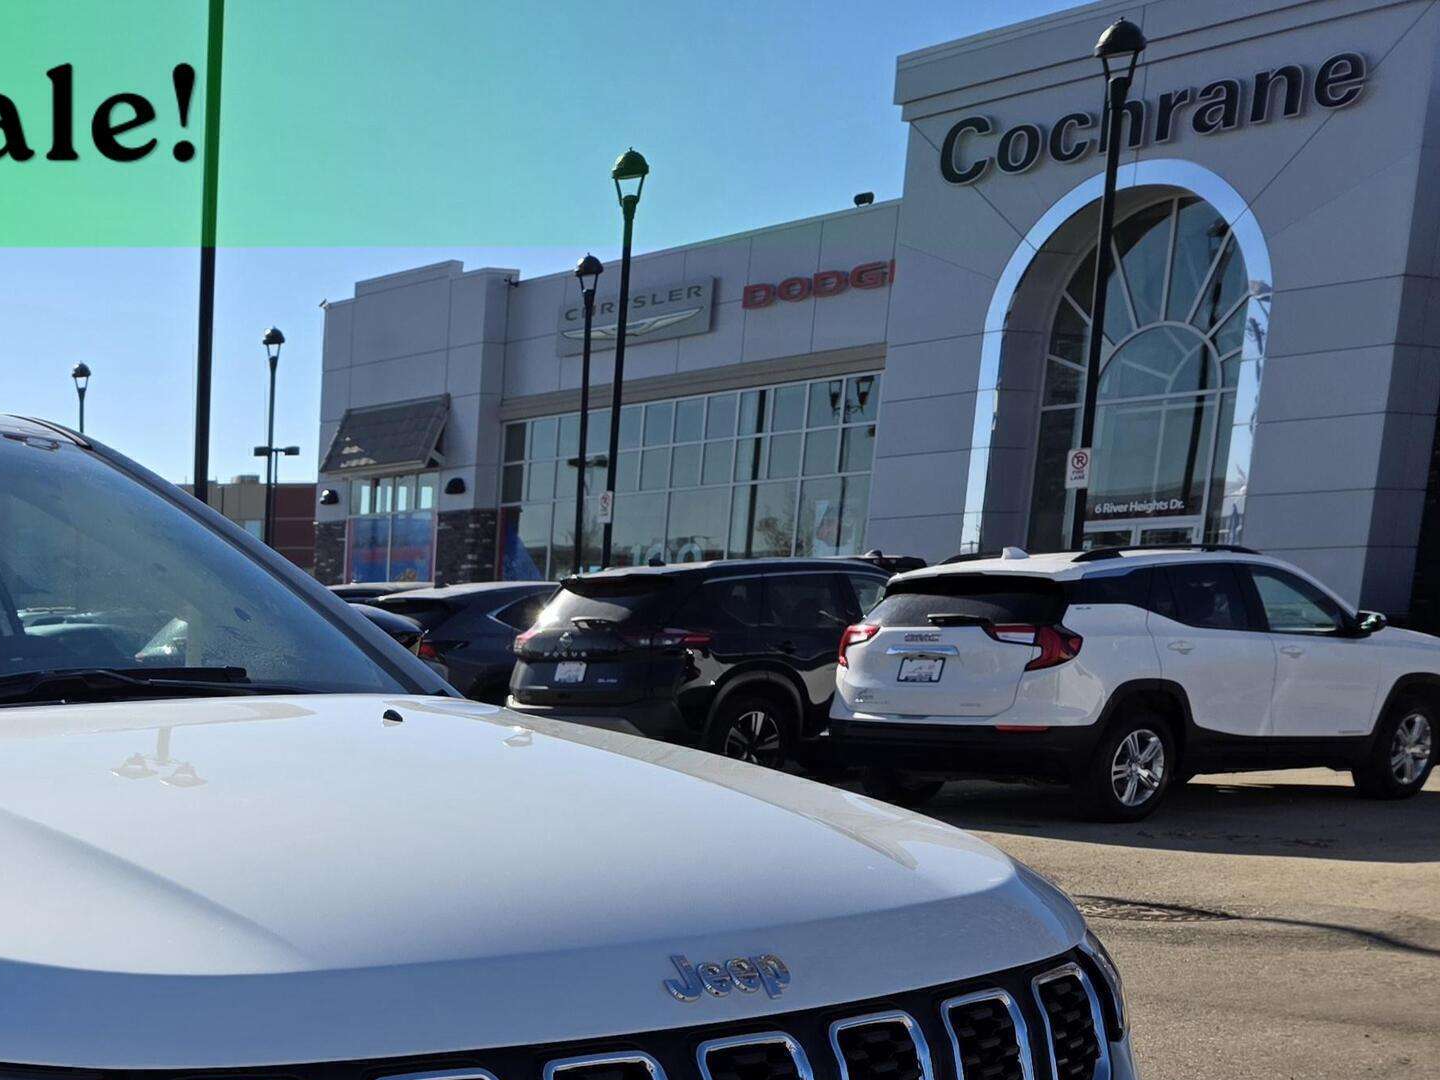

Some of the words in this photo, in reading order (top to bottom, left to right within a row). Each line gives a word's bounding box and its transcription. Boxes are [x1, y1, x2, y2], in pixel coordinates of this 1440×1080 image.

[939, 51, 1370, 185] Cochrane
[741, 258, 896, 310] DODG
[1094, 503, 1102, 514] 6
[1103, 502, 1128, 513] River
[1129, 499, 1168, 513] Heights
[1169, 499, 1185, 510] Dr.
[663, 953, 792, 1003] Jeep
